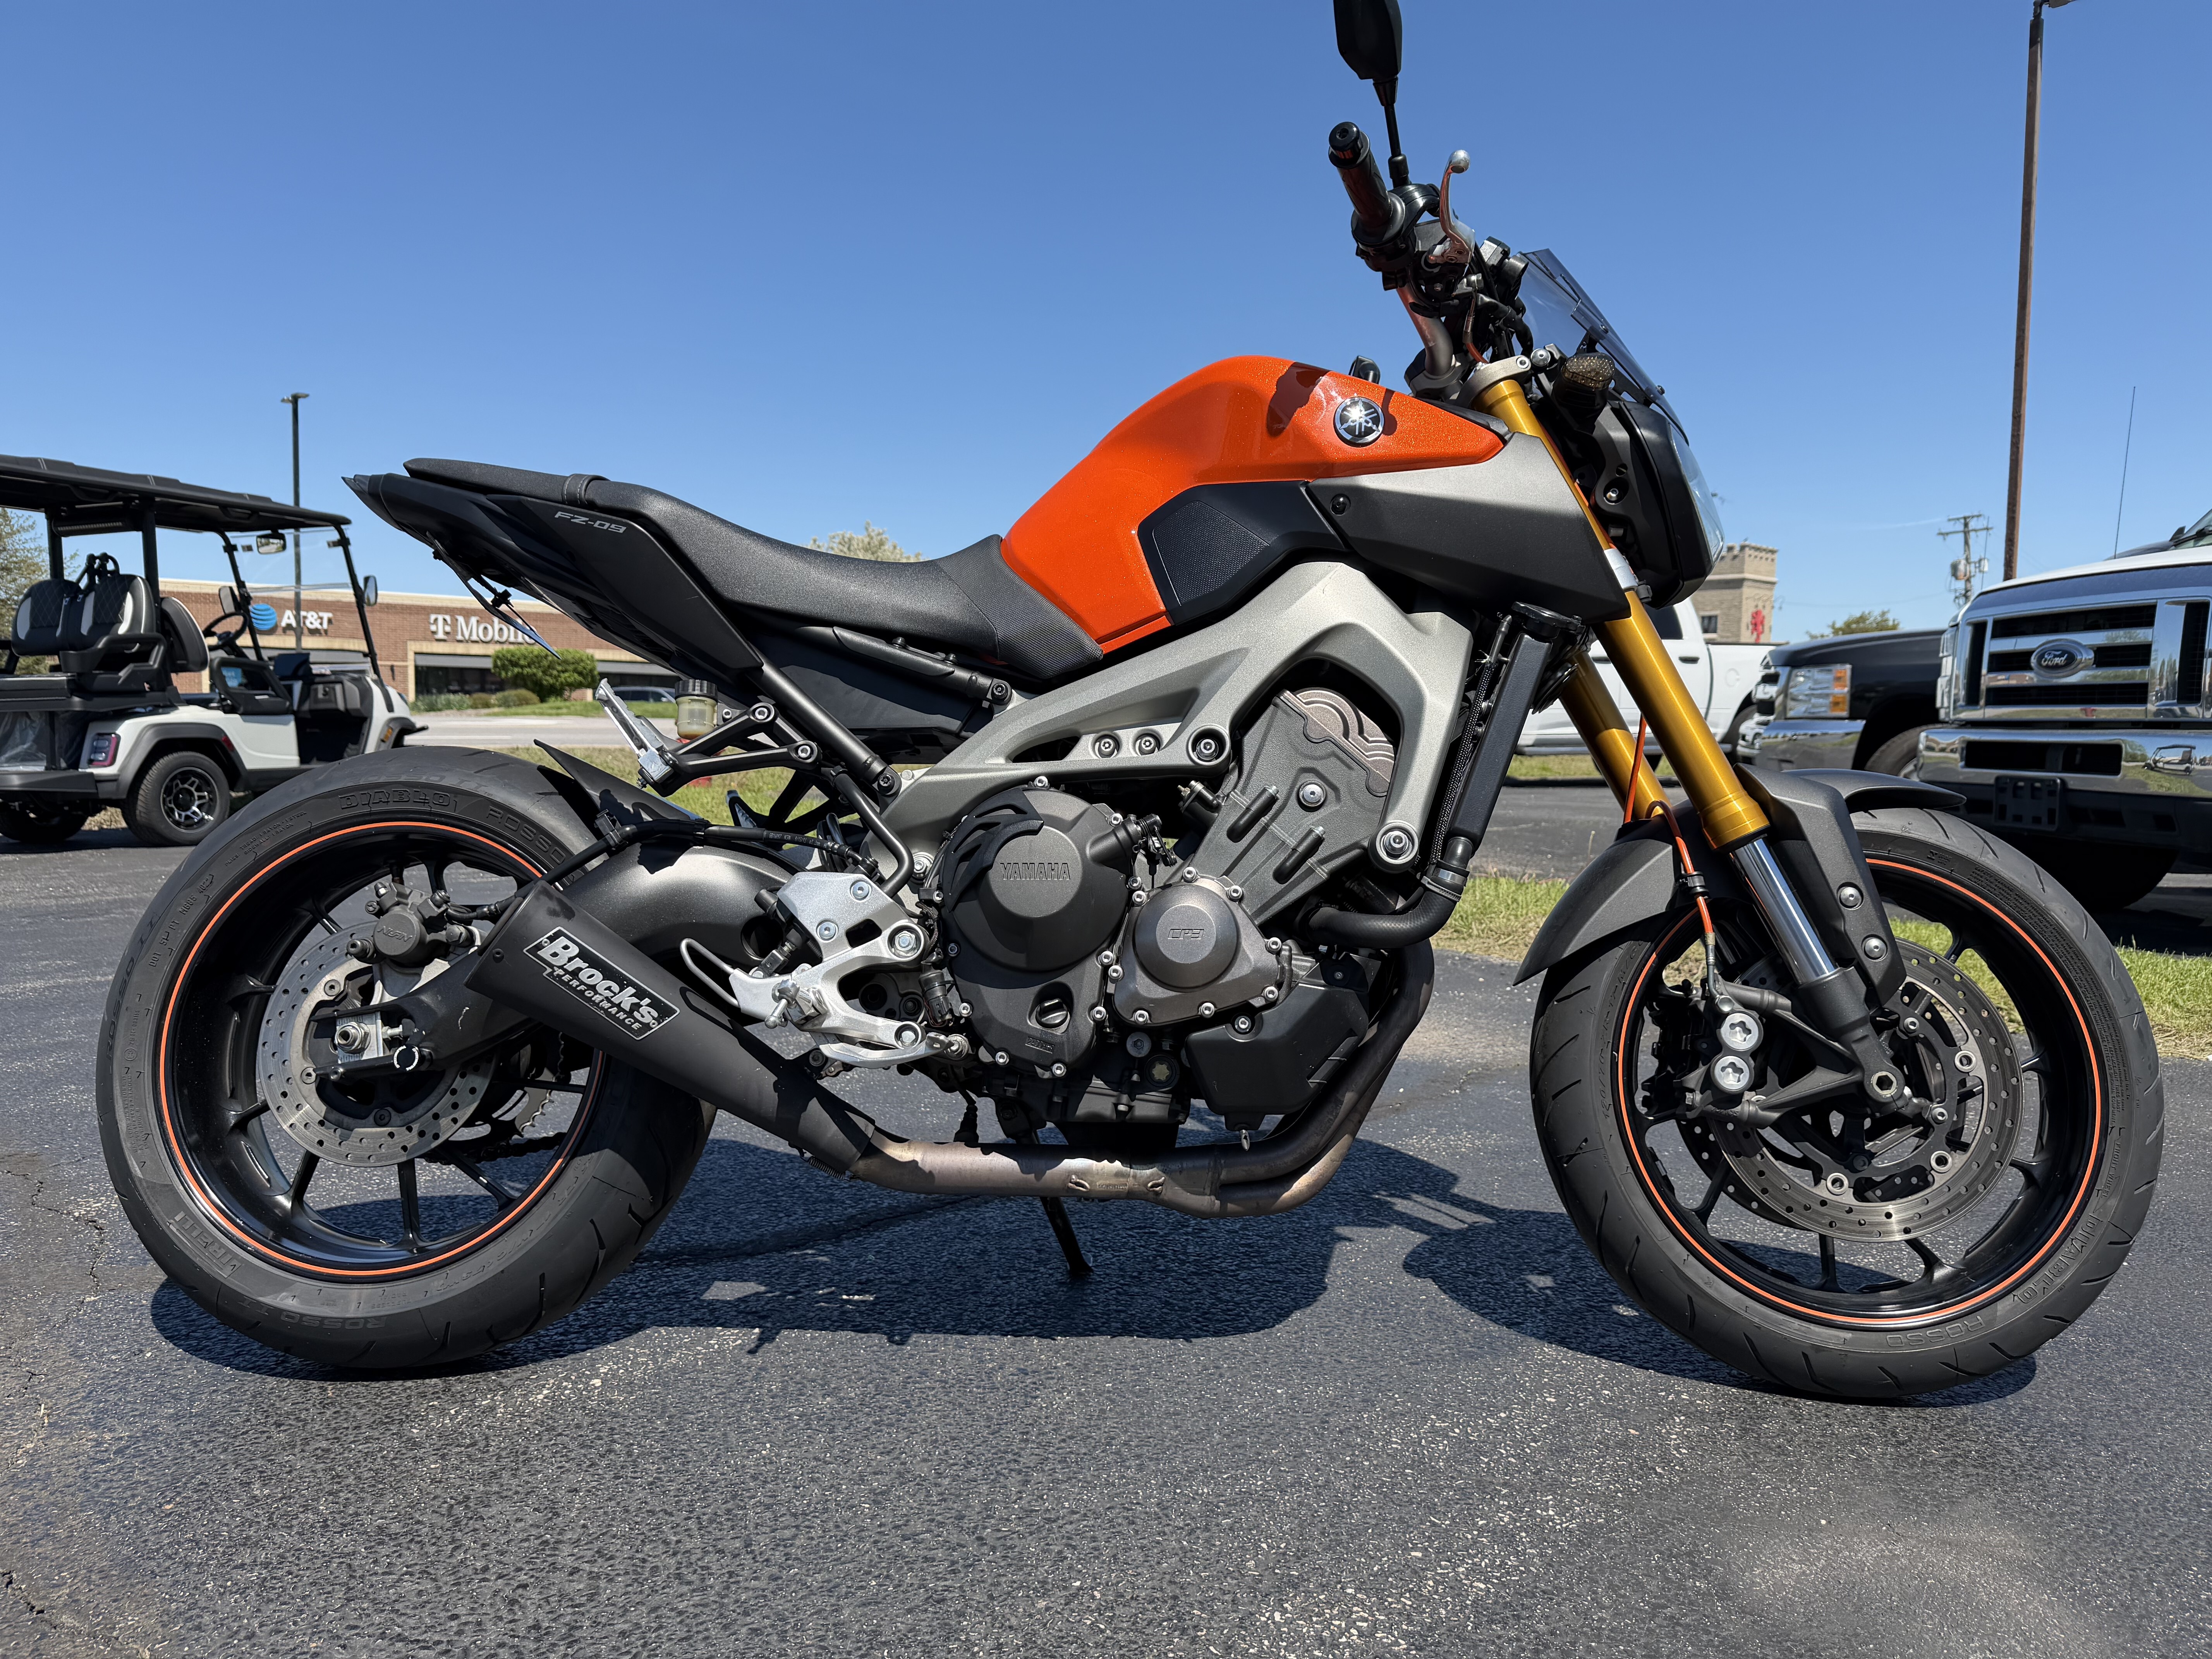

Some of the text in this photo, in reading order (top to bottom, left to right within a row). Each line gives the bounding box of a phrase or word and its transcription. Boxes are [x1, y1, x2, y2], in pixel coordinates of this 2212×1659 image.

[555, 512, 627, 533] FZ-09
[281, 610, 333, 630] AT&T
[2042, 651, 2068, 666] Ford
[338, 788, 452, 811] DIABLO
[484, 804, 569, 866] ROSSO
[1000, 862, 1070, 880] YAMAHA
[1168, 929, 1204, 939] CP3
[538, 936, 658, 1023] Brock's
[553, 967, 642, 1030] PERFORMANCE
[2100, 1142, 2122, 1200] FRONT WHEEL
[2016, 1214, 2102, 1304] DIABLO
[280, 1309, 387, 1329] ROSSO
[1885, 1314, 1986, 1348] ROSSO
